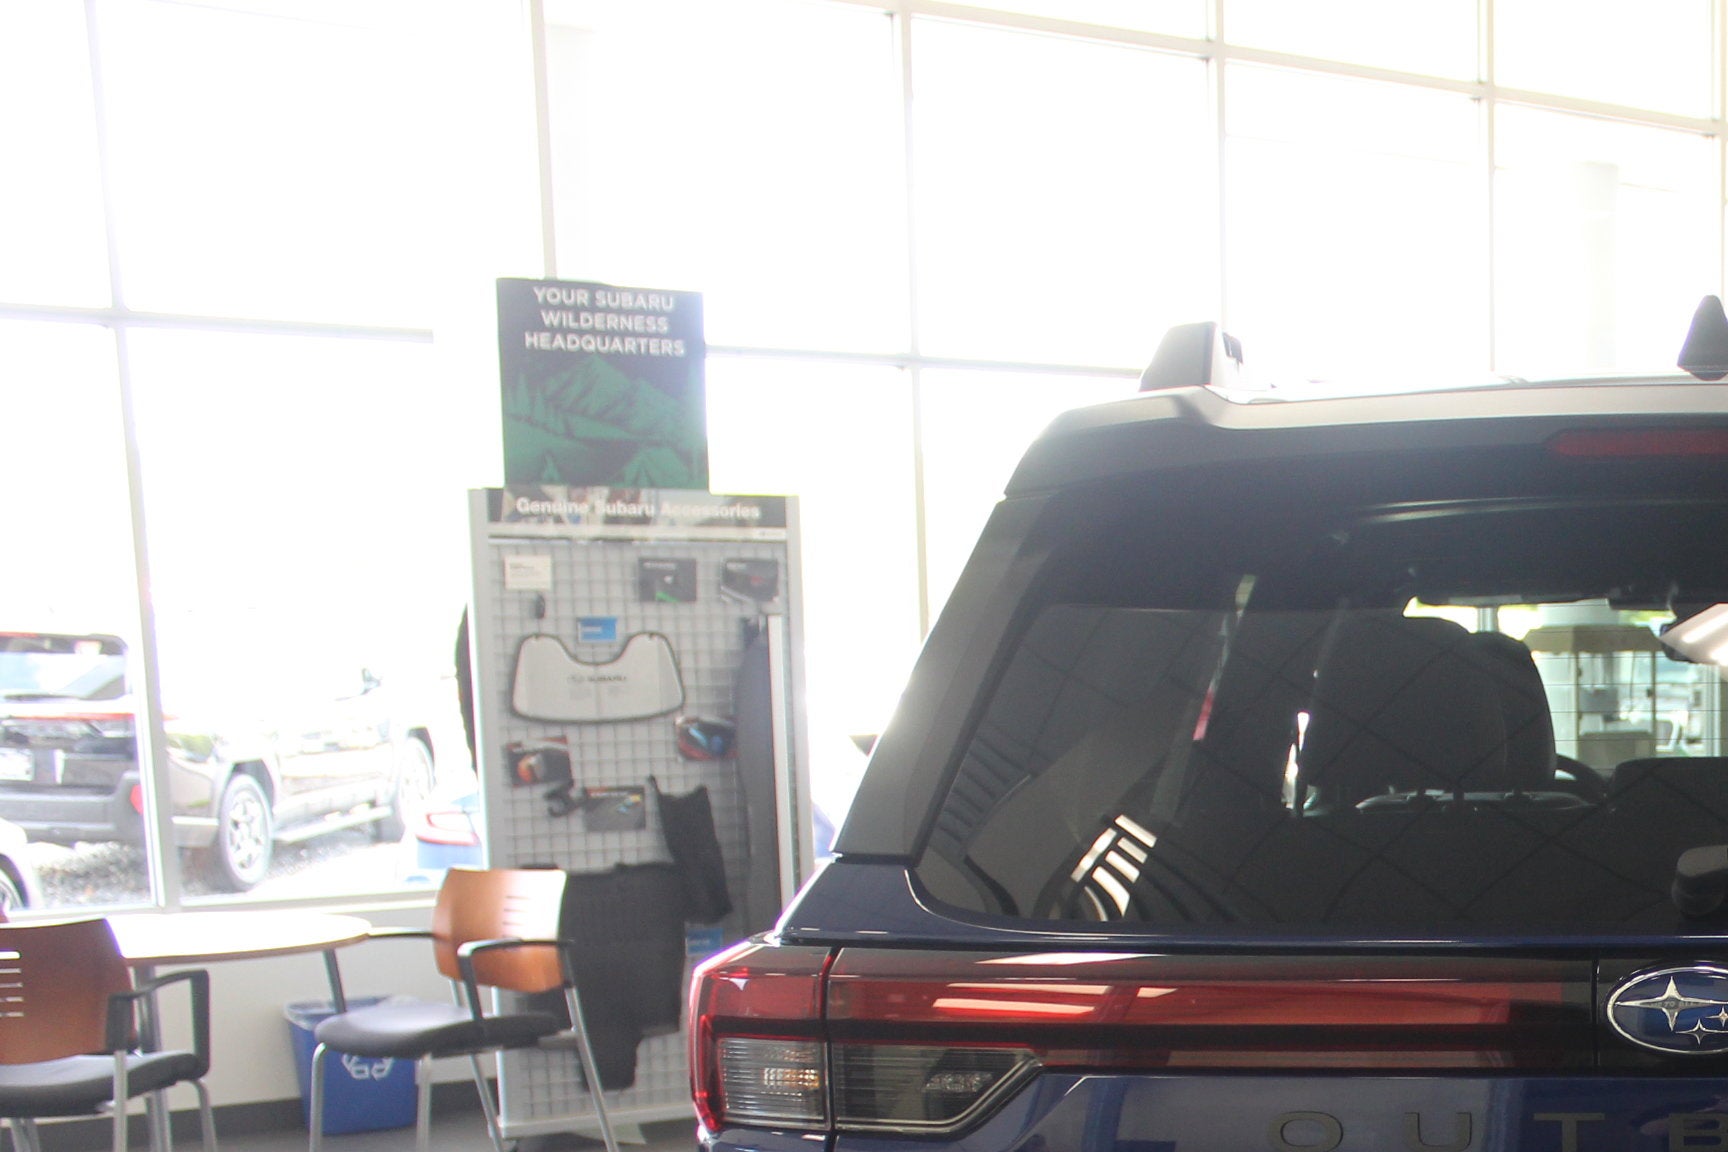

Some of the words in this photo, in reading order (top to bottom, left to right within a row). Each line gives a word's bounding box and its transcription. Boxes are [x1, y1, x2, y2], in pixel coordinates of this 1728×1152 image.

[533, 286, 589, 308] YOUR
[594, 289, 675, 312] SUBARU
[540, 309, 670, 333] WILDERNESS
[524, 332, 686, 357] HEADQUARTERS
[516, 497, 589, 517] Genuine
[594, 498, 656, 518] Subaru
[660, 502, 761, 520] Accessories
